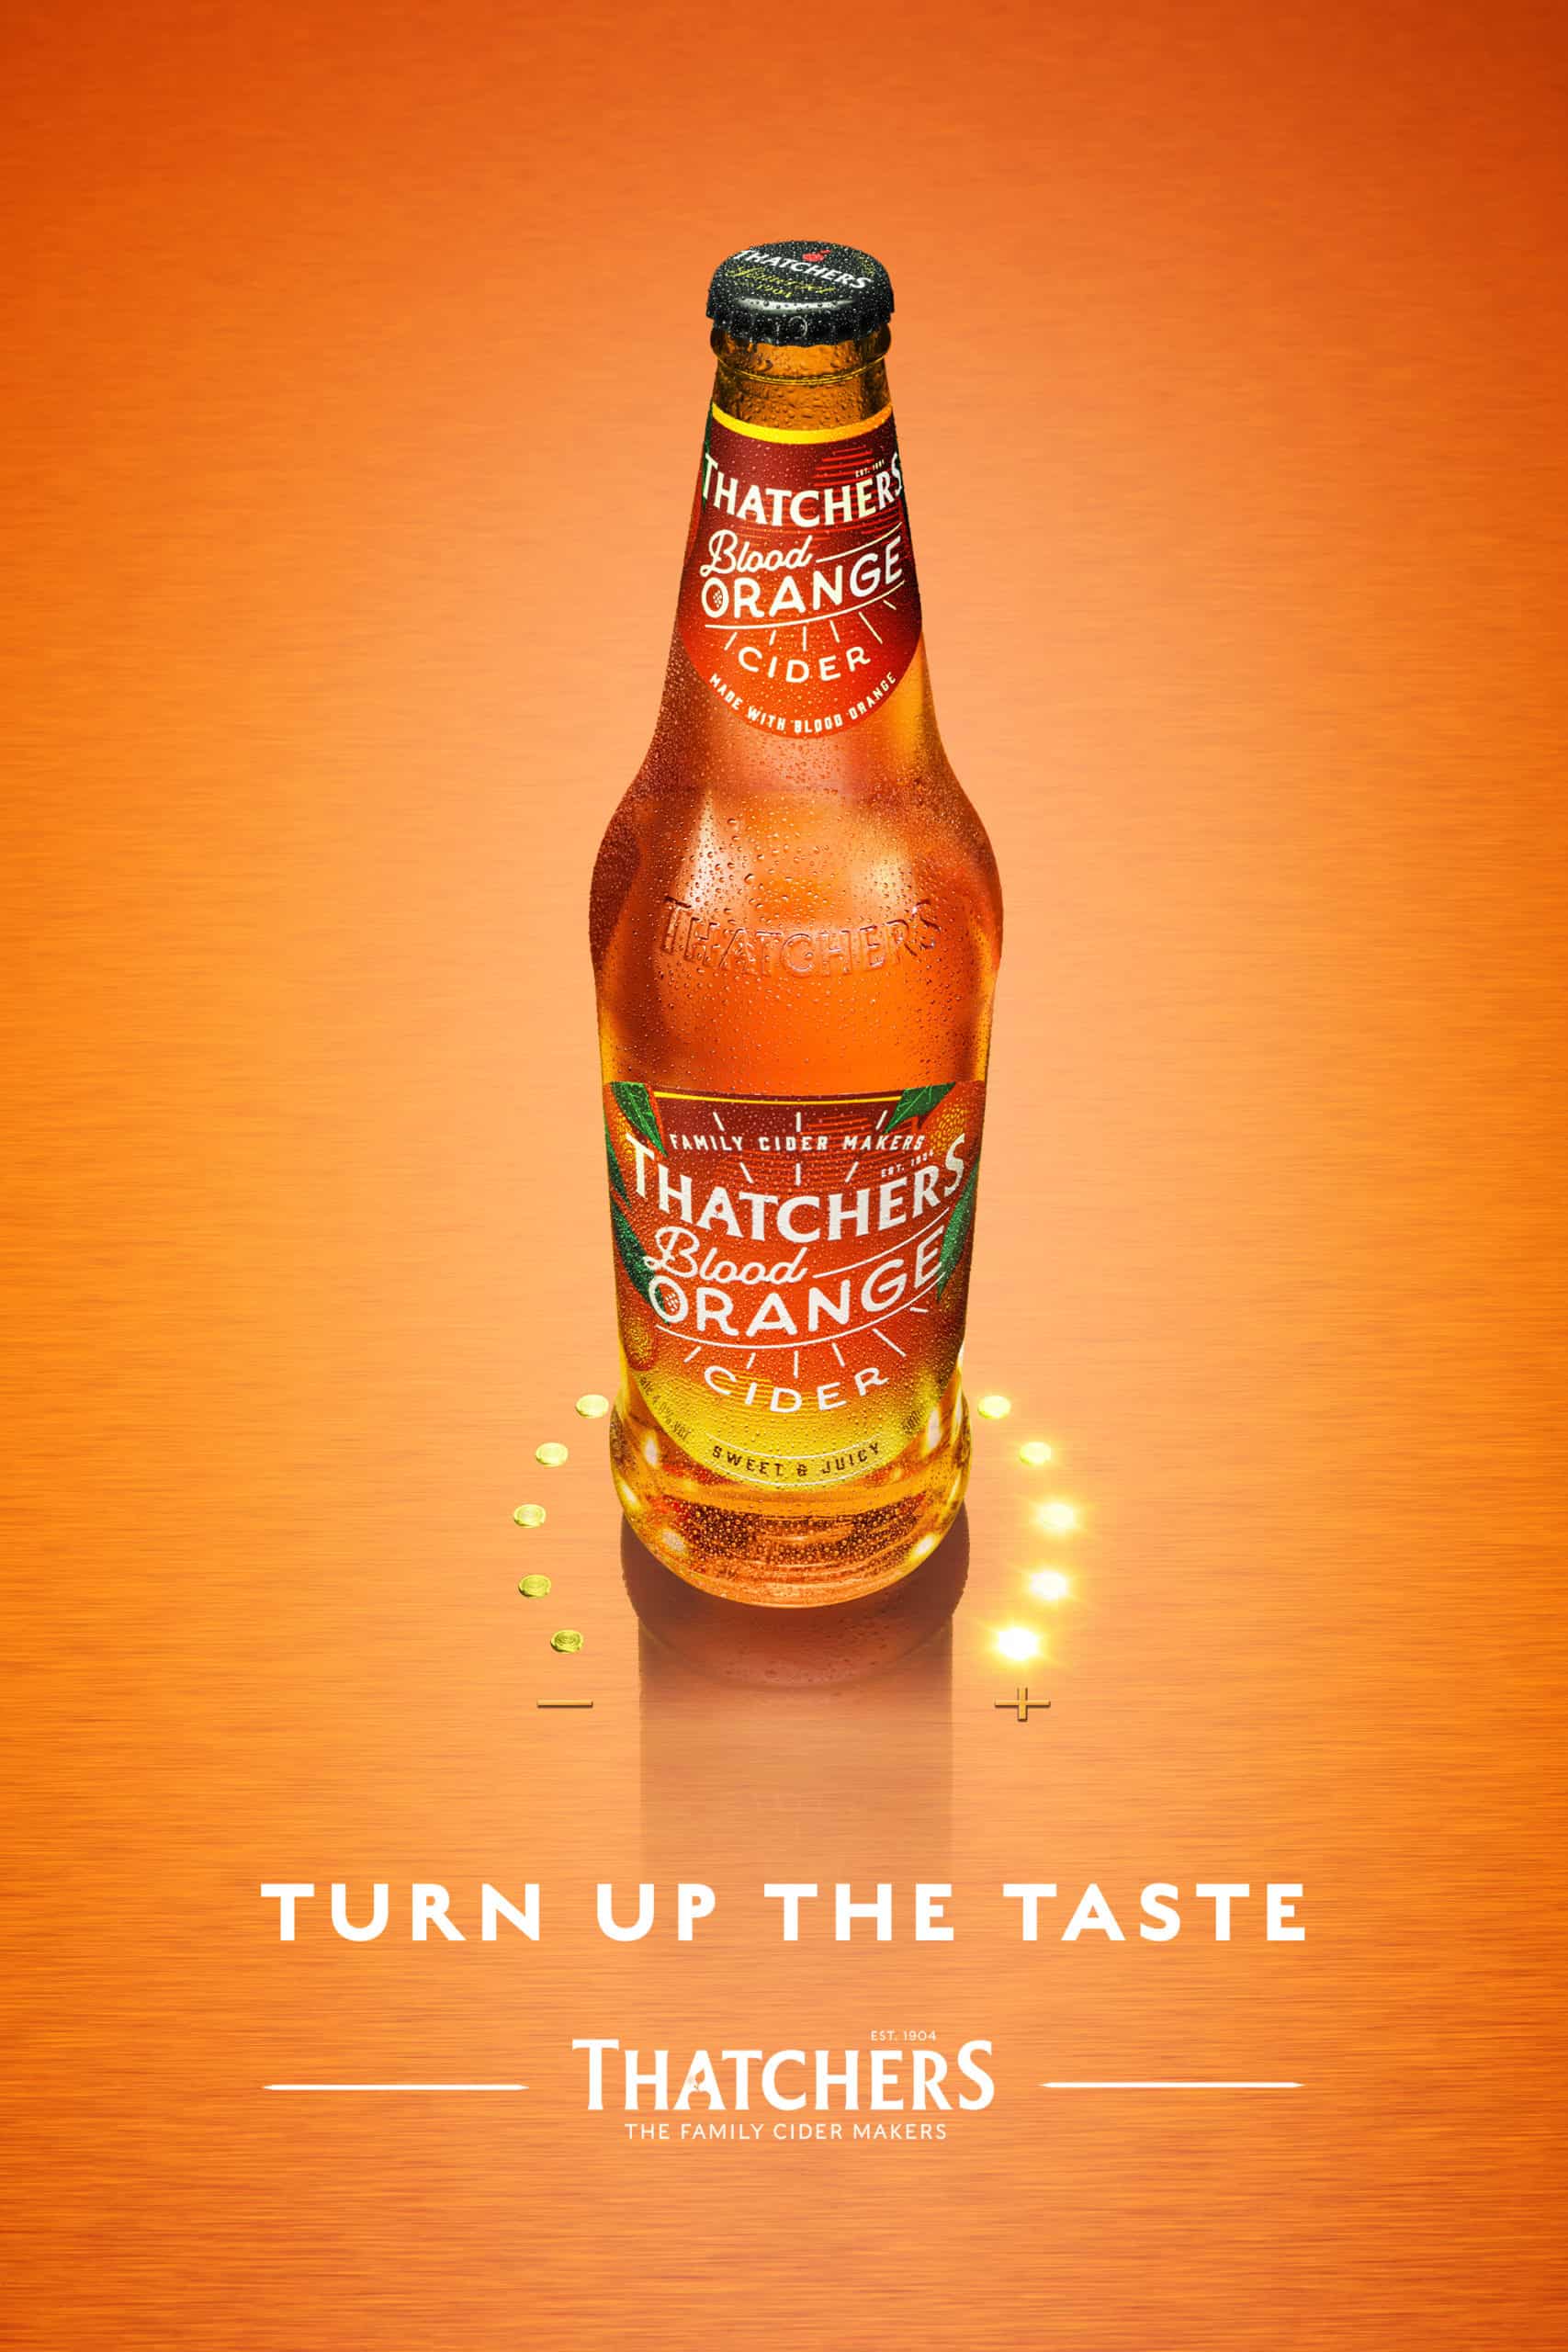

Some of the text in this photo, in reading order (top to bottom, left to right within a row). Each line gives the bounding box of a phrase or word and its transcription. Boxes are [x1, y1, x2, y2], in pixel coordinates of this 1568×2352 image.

[733, 249, 873, 289] THATCHERS
[702, 450, 903, 527] THATCHERS
[700, 529, 813, 577] Blood
[701, 536, 902, 618] ORANGE
[738, 646, 871, 683] CIDER
[709, 672, 897, 733] MADE WITH BLOOD ORANGE
[659, 896, 942, 978] THATCHERS
[670, 1133, 926, 1152] FAMILY CIDER MAKERS
[626, 1133, 966, 1242] THATCHERS
[642, 1227, 809, 1284] Blood
[649, 1224, 945, 1337] ORANGE
[704, 1365, 889, 1414] CIDER
[712, 1442, 881, 1476] SWEET & JUICY
